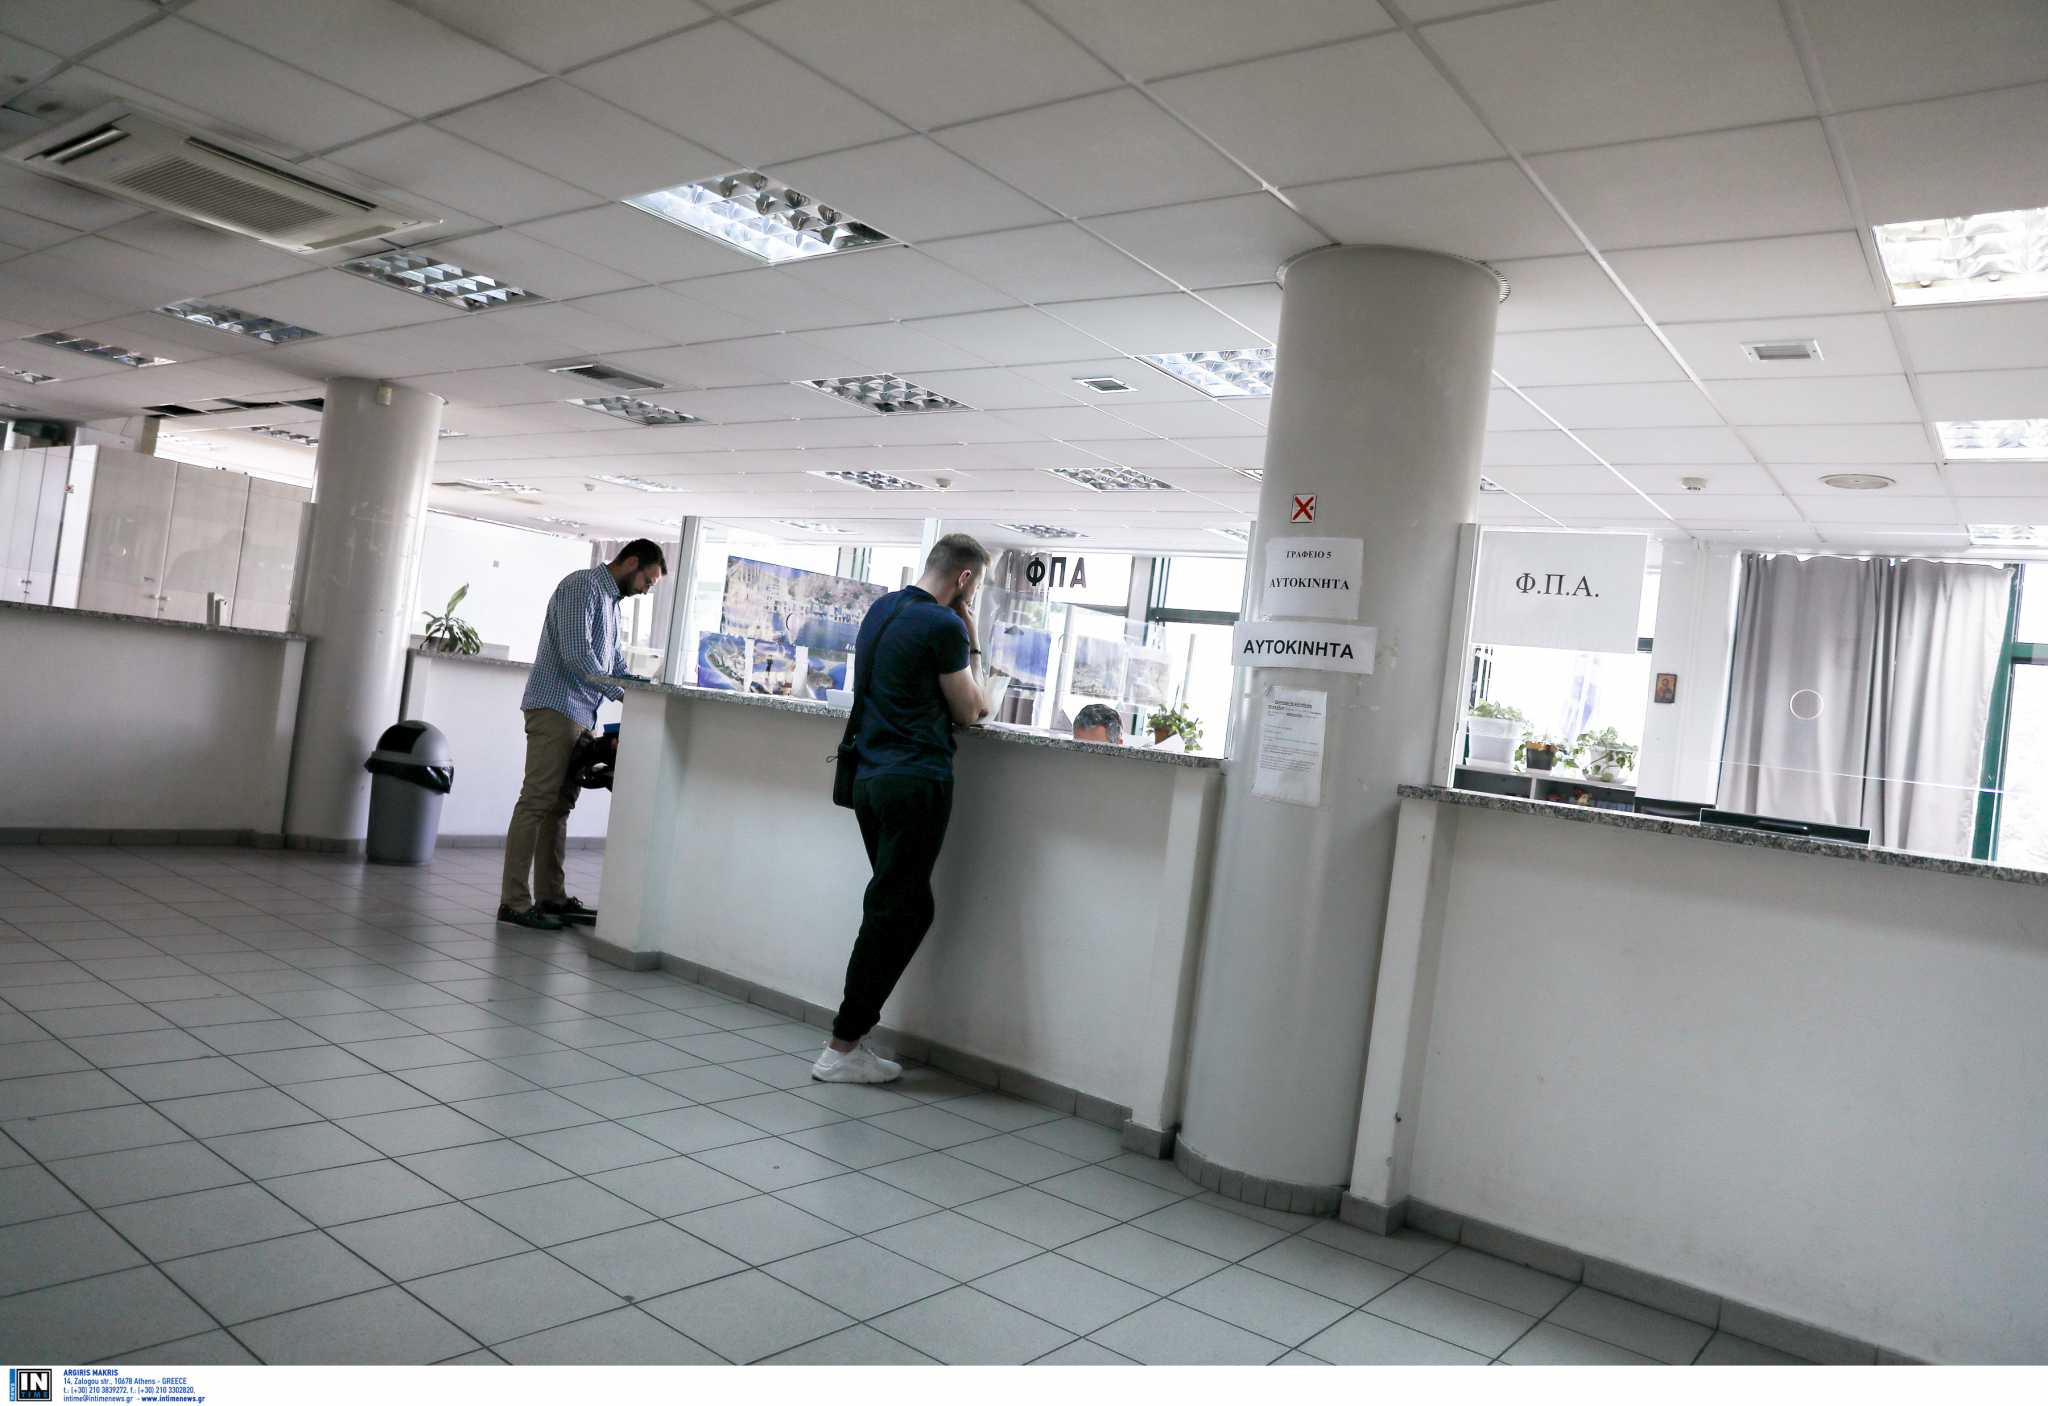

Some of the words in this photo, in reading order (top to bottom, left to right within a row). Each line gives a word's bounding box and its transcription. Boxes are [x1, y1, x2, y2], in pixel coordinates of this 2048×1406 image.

[1286, 550, 1325, 559] ΓΡΑΦΕΙΟ
[1326, 551, 1332, 559] 5
[1026, 557, 1086, 588] ΦΠΑ
[1270, 577, 1350, 590] ΑΥΤΟΚΙΝΗΤΑ
[1516, 572, 1599, 598] Φ.Π.Α.
[1243, 639, 1354, 660] ΑΥΤΟΚΙΝΗΤΑ
